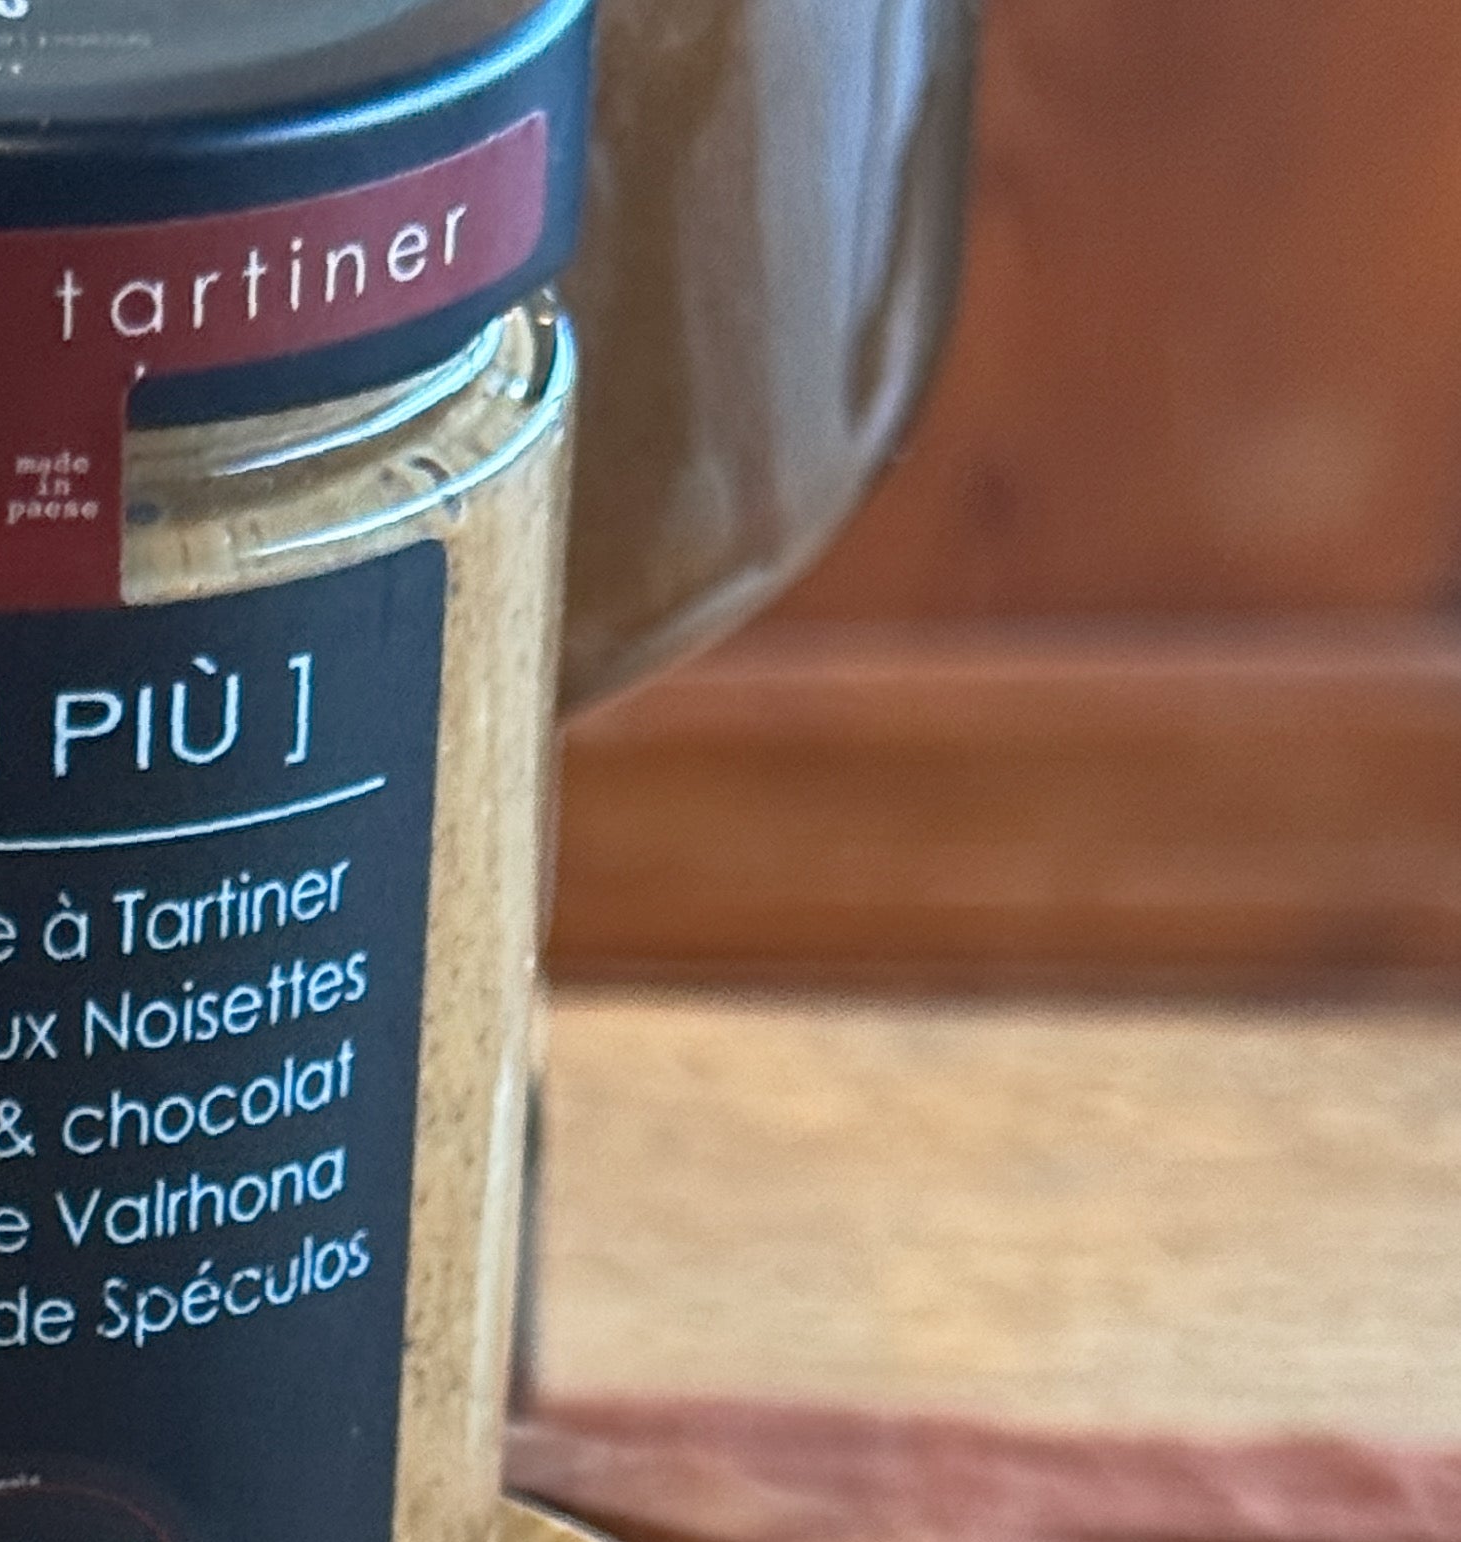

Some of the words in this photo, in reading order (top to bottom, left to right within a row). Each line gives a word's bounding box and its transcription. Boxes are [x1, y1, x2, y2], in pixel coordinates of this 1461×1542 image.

[56, 205, 468, 341] tartiner
[15, 449, 90, 476] made
[37, 473, 71, 497] in
[53, 656, 239, 777] PIÙ
[43, 892, 89, 961] à
[112, 859, 351, 957] Tartiner
[82, 950, 368, 1059] Noisettes
[62, 1040, 354, 1156] chocolat
[55, 1146, 348, 1248] Valrhona
[96, 1229, 371, 1348] Spéculos
